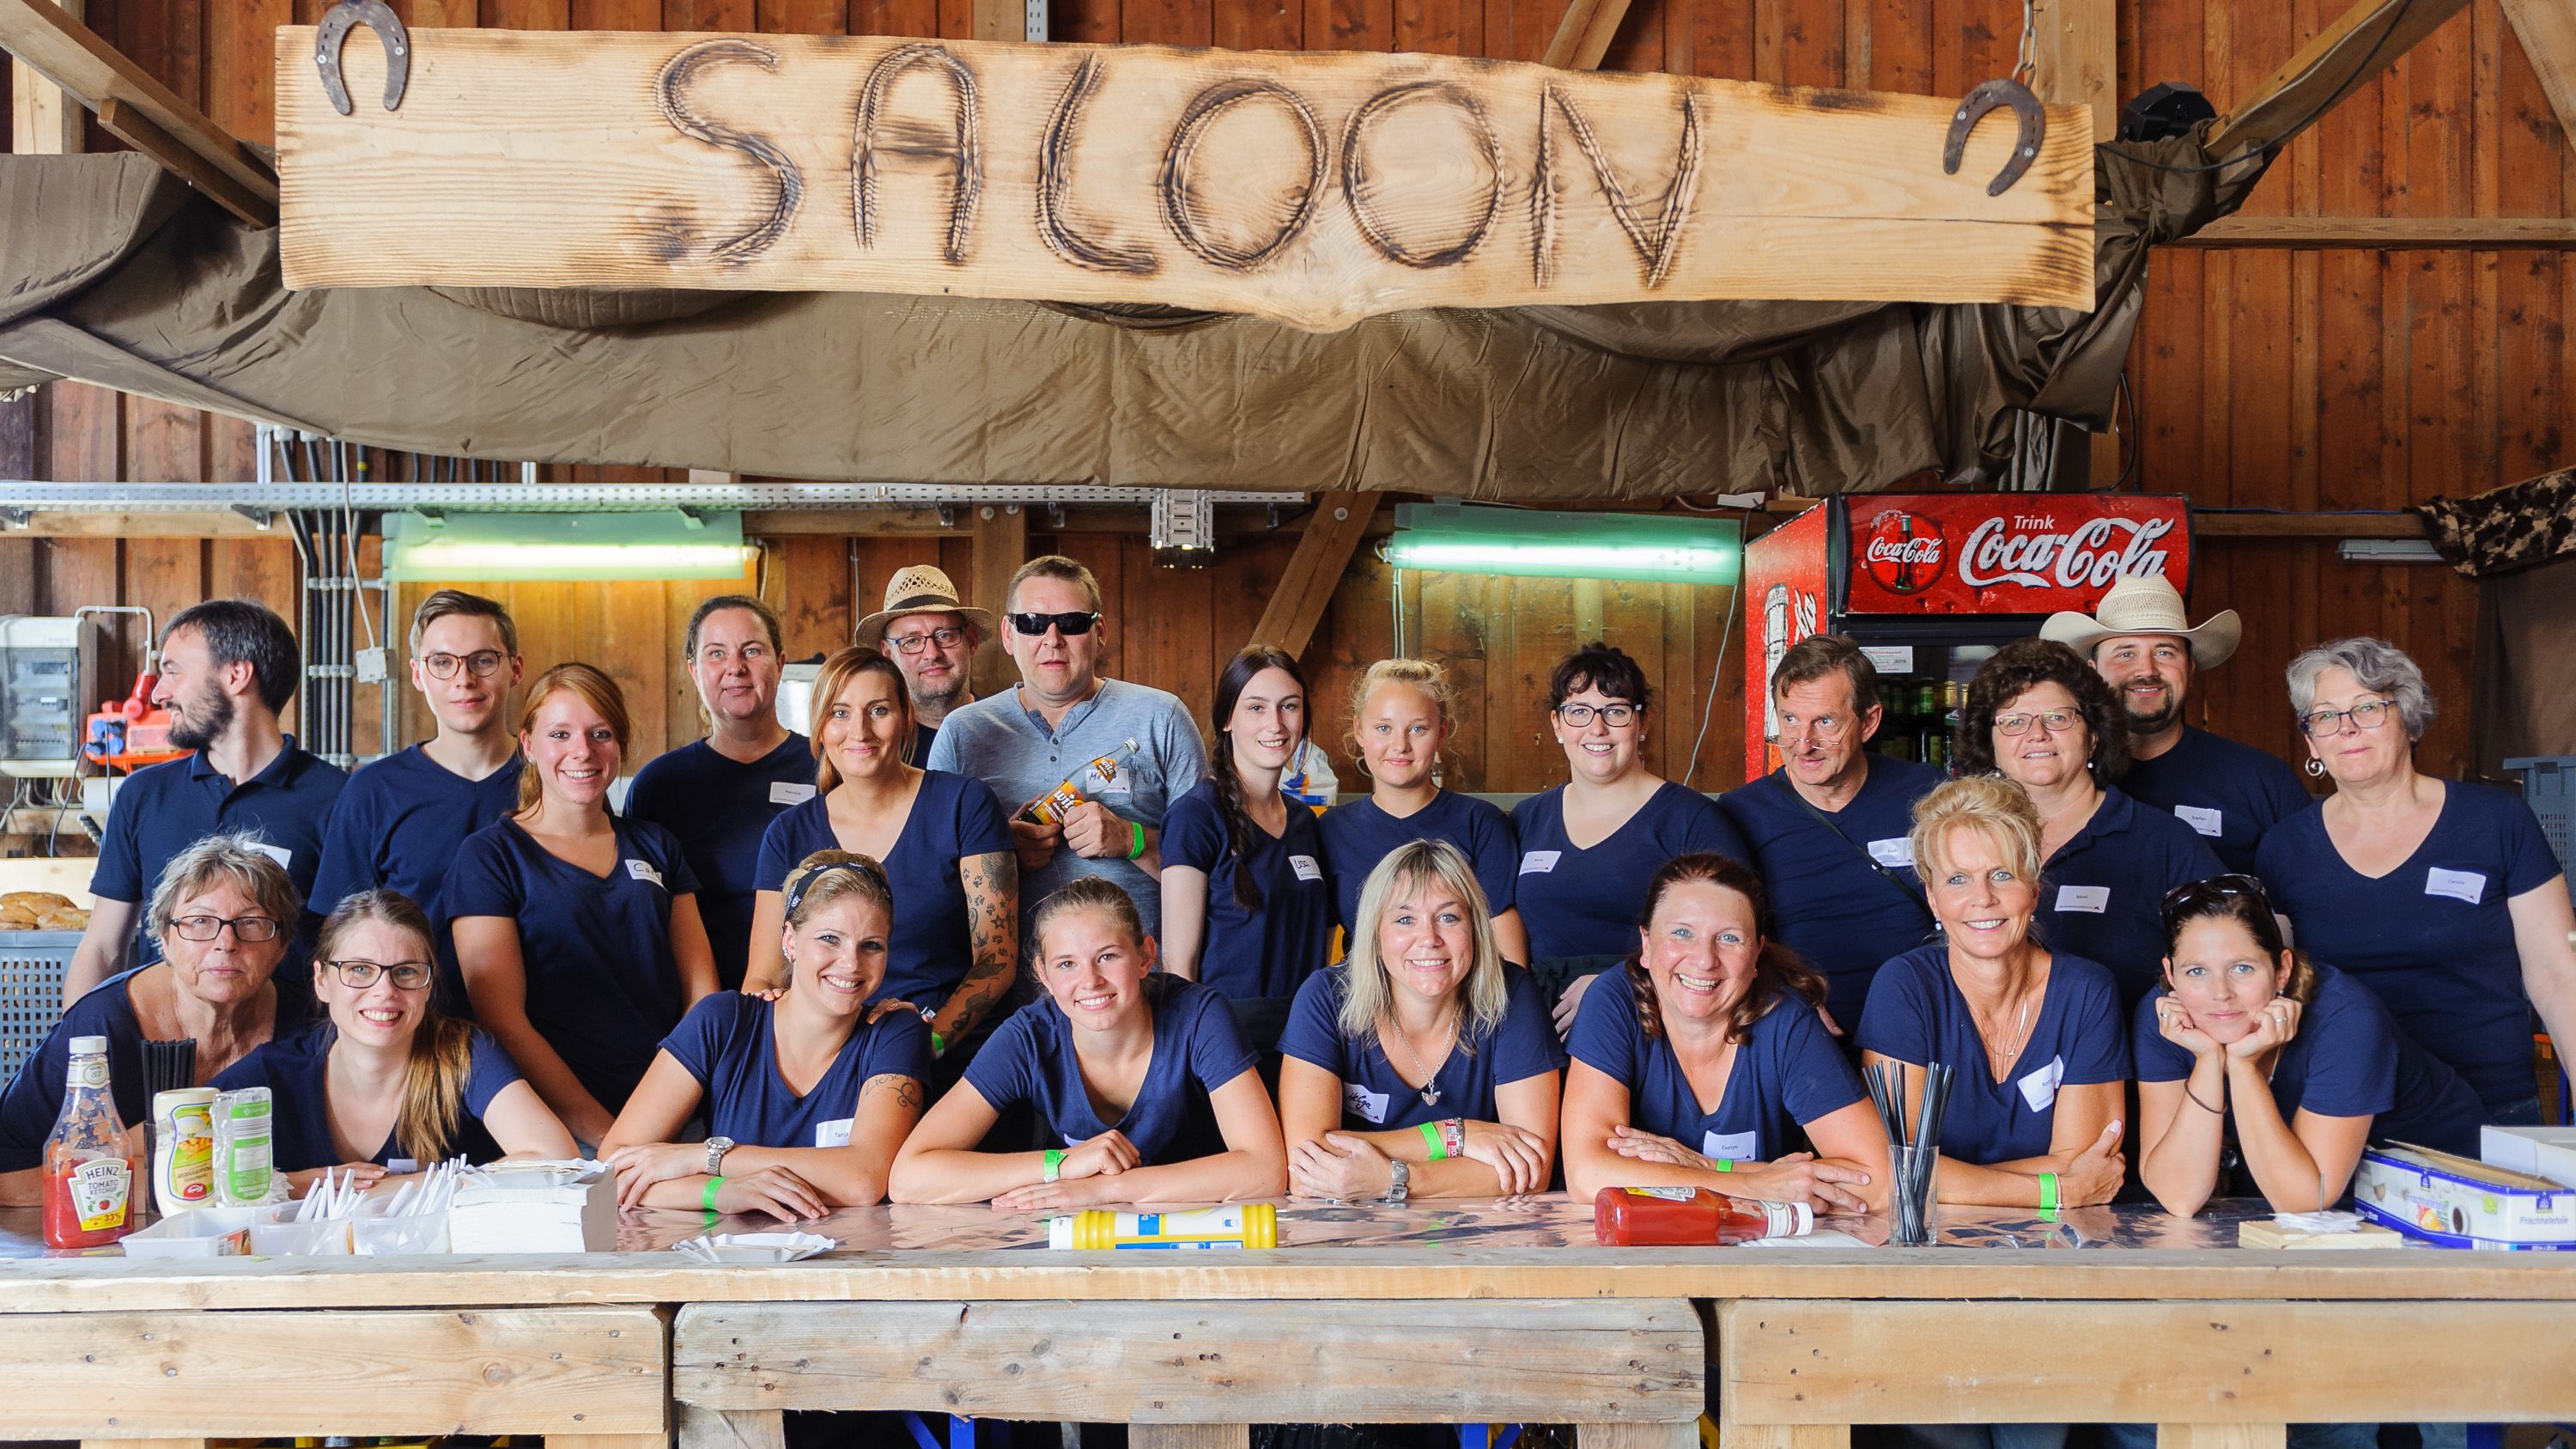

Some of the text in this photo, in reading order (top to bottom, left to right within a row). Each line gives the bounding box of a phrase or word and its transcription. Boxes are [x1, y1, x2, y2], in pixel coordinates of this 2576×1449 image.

[655, 38, 1706, 289] SALOON
[2014, 514, 2057, 530] Trink
[1867, 536, 1943, 563] Coca-Cola
[1958, 516, 2174, 588] Coca-Cola
[86, 1166, 119, 1180] HEINZ
[88, 1179, 118, 1190] TOMATO
